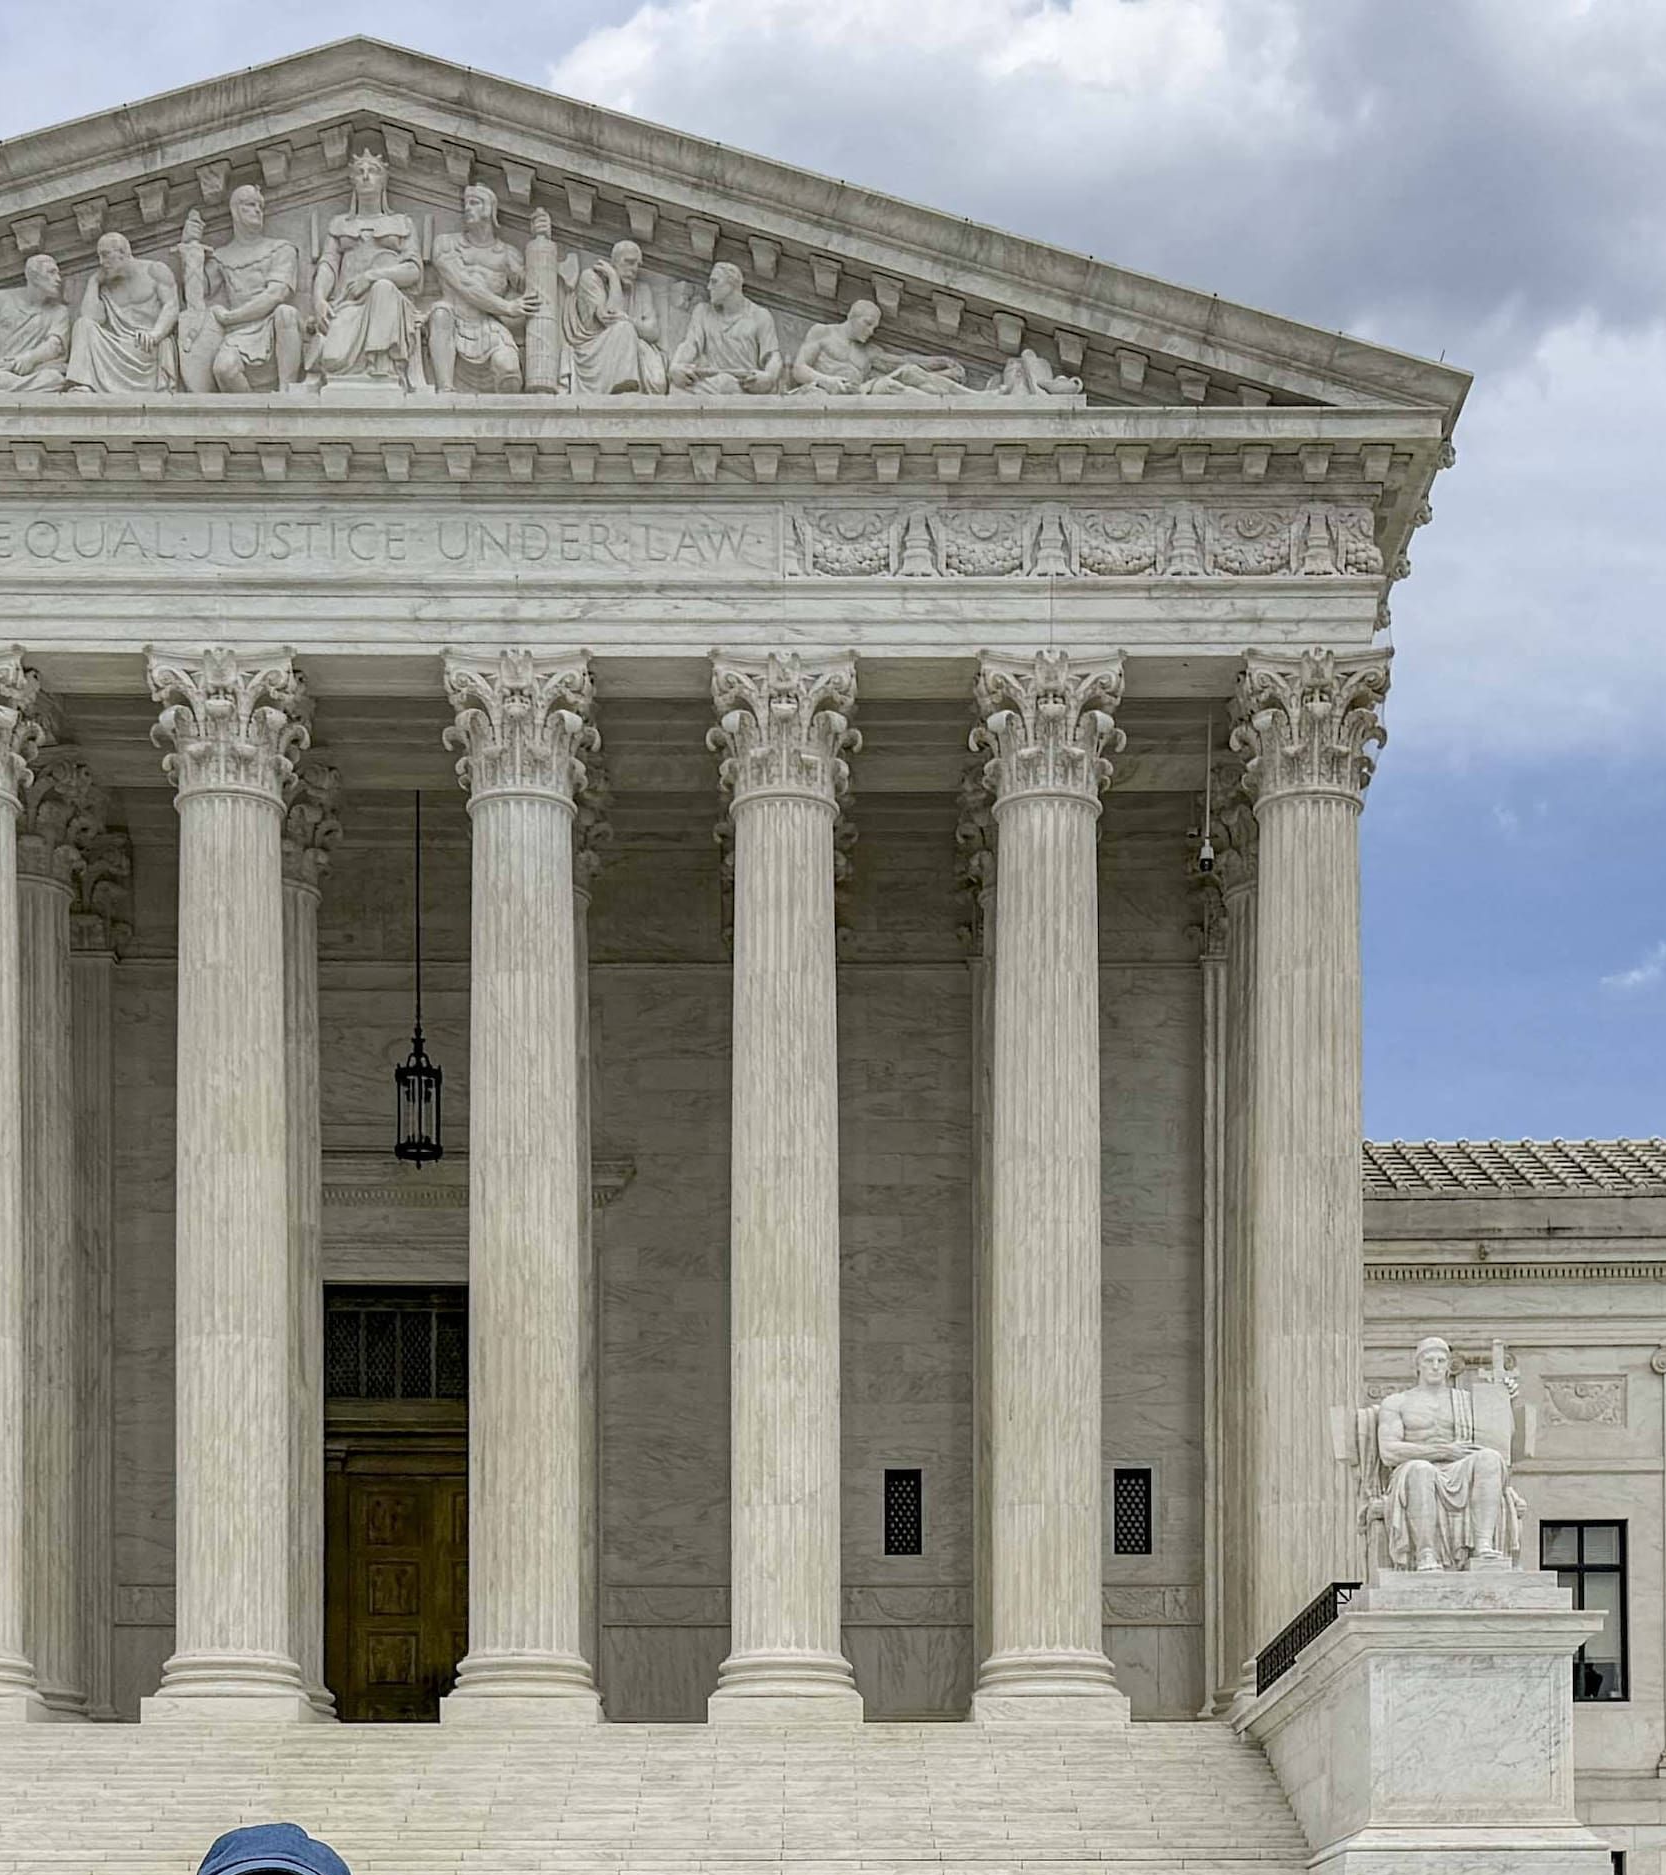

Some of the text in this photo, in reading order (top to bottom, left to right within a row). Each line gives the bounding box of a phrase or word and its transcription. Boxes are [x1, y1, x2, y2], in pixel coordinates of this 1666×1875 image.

[193, 519, 407, 562] JUSTICE
[437, 520, 623, 562] UNDER
[642, 521, 749, 562] LAW
